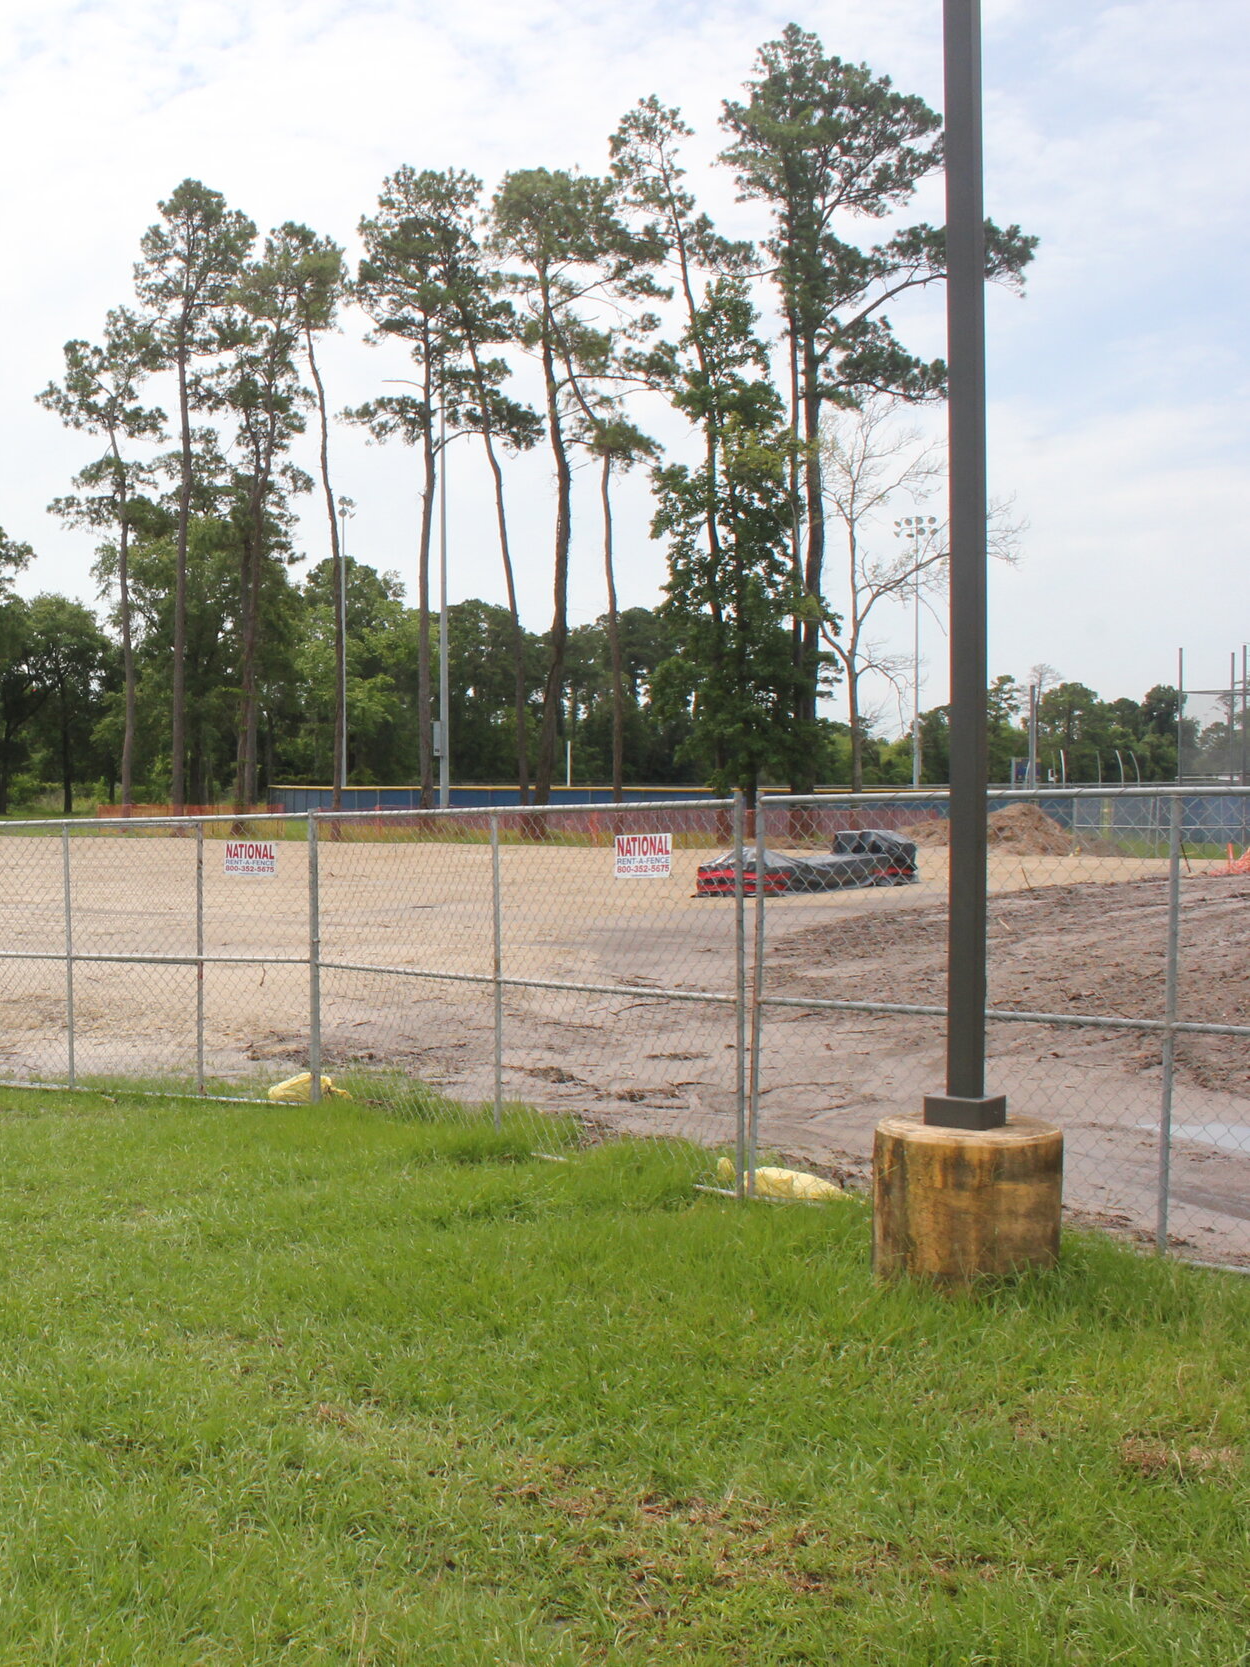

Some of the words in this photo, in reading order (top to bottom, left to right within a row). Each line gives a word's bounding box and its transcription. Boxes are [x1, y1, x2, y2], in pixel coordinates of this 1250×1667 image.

[617, 835, 670, 856] NATIONAL
[226, 843, 275, 860] NATIONAL
[617, 857, 670, 865] RENT-A-FENCE
[226, 865, 275, 873] 800-352-5675
[617, 864, 670, 873] 800-352-5675
